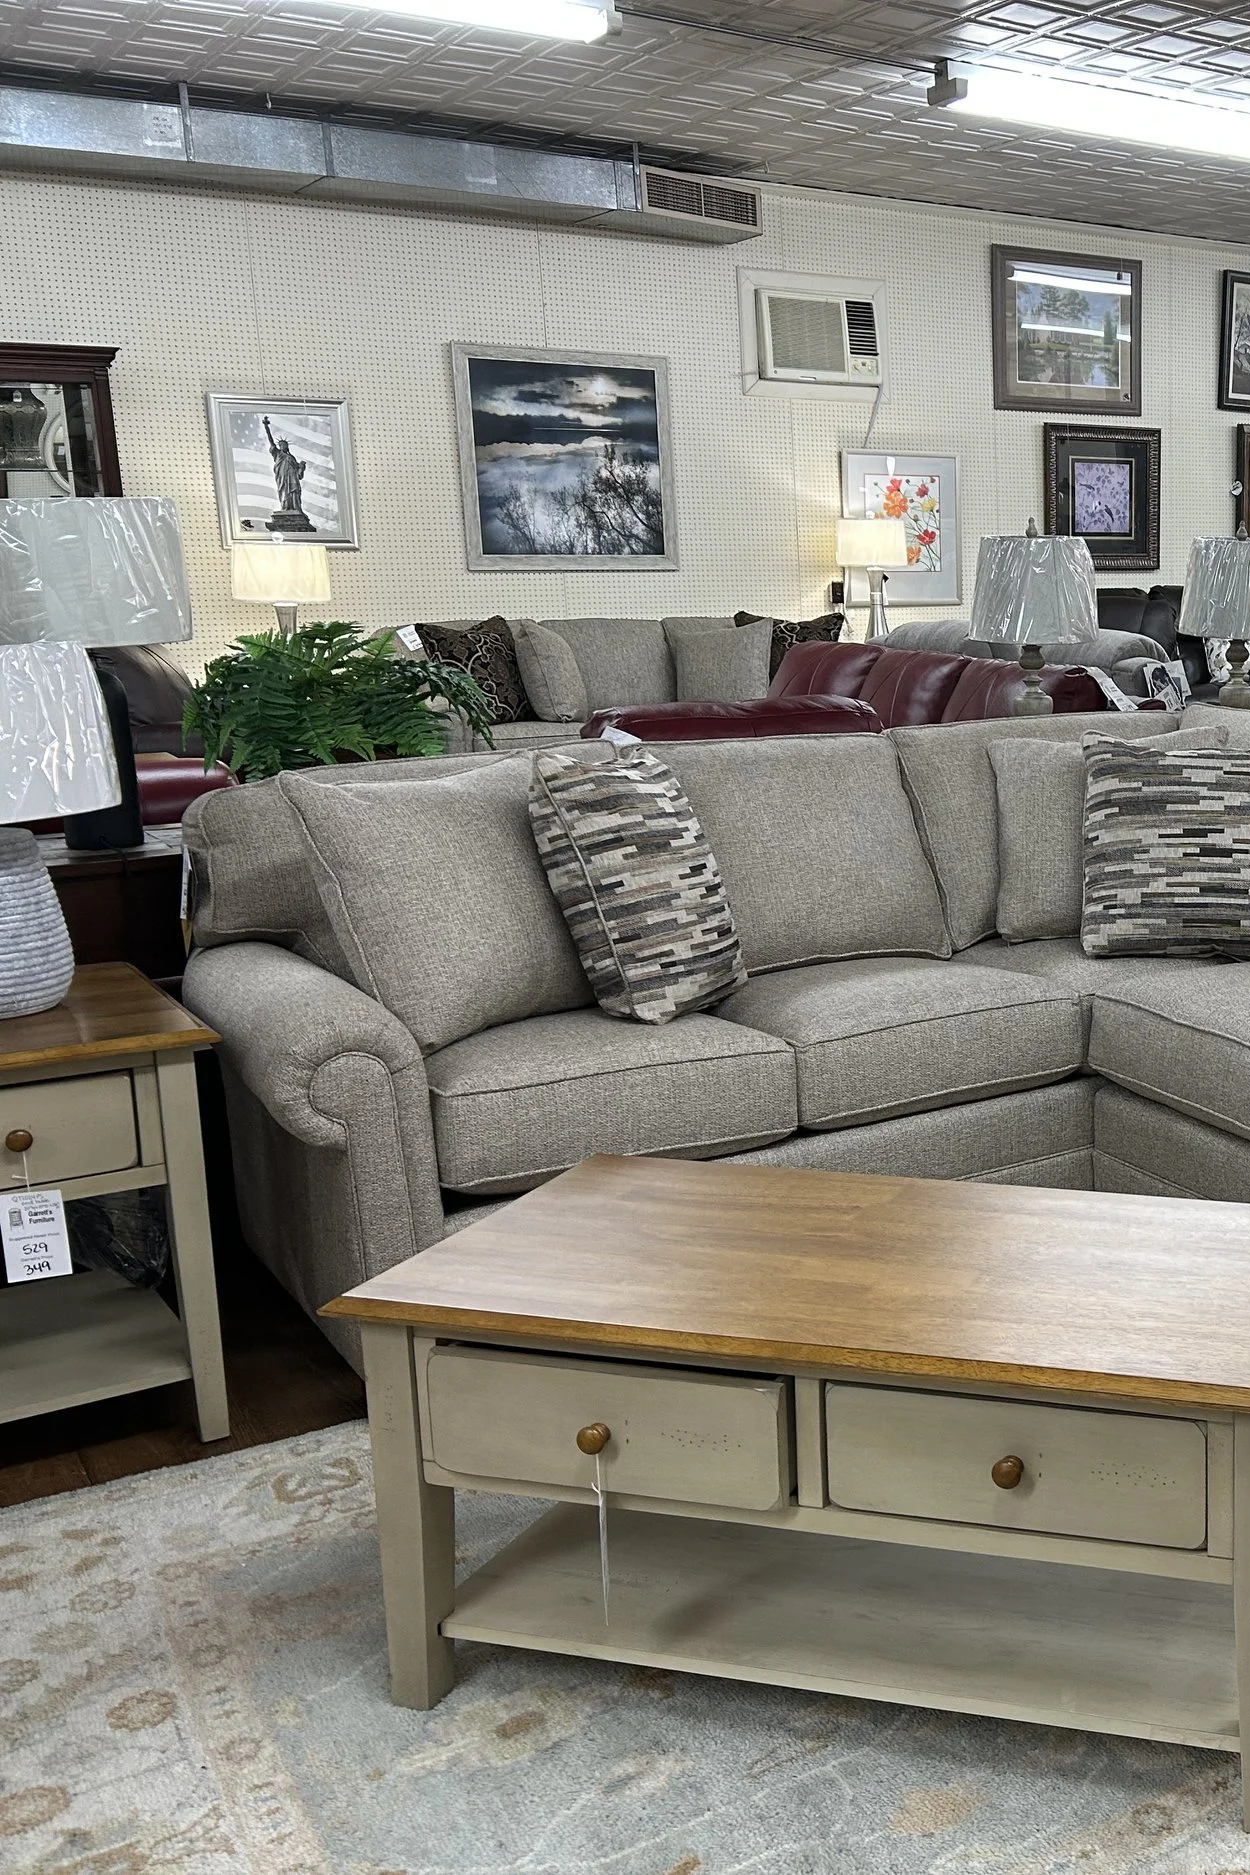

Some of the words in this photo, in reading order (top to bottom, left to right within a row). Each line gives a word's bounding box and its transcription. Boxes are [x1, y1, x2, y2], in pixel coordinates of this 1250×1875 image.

[28, 1209, 53, 1217] Garrett's
[22, 1241, 49, 1255] 529
[23, 1260, 52, 1276] 349
